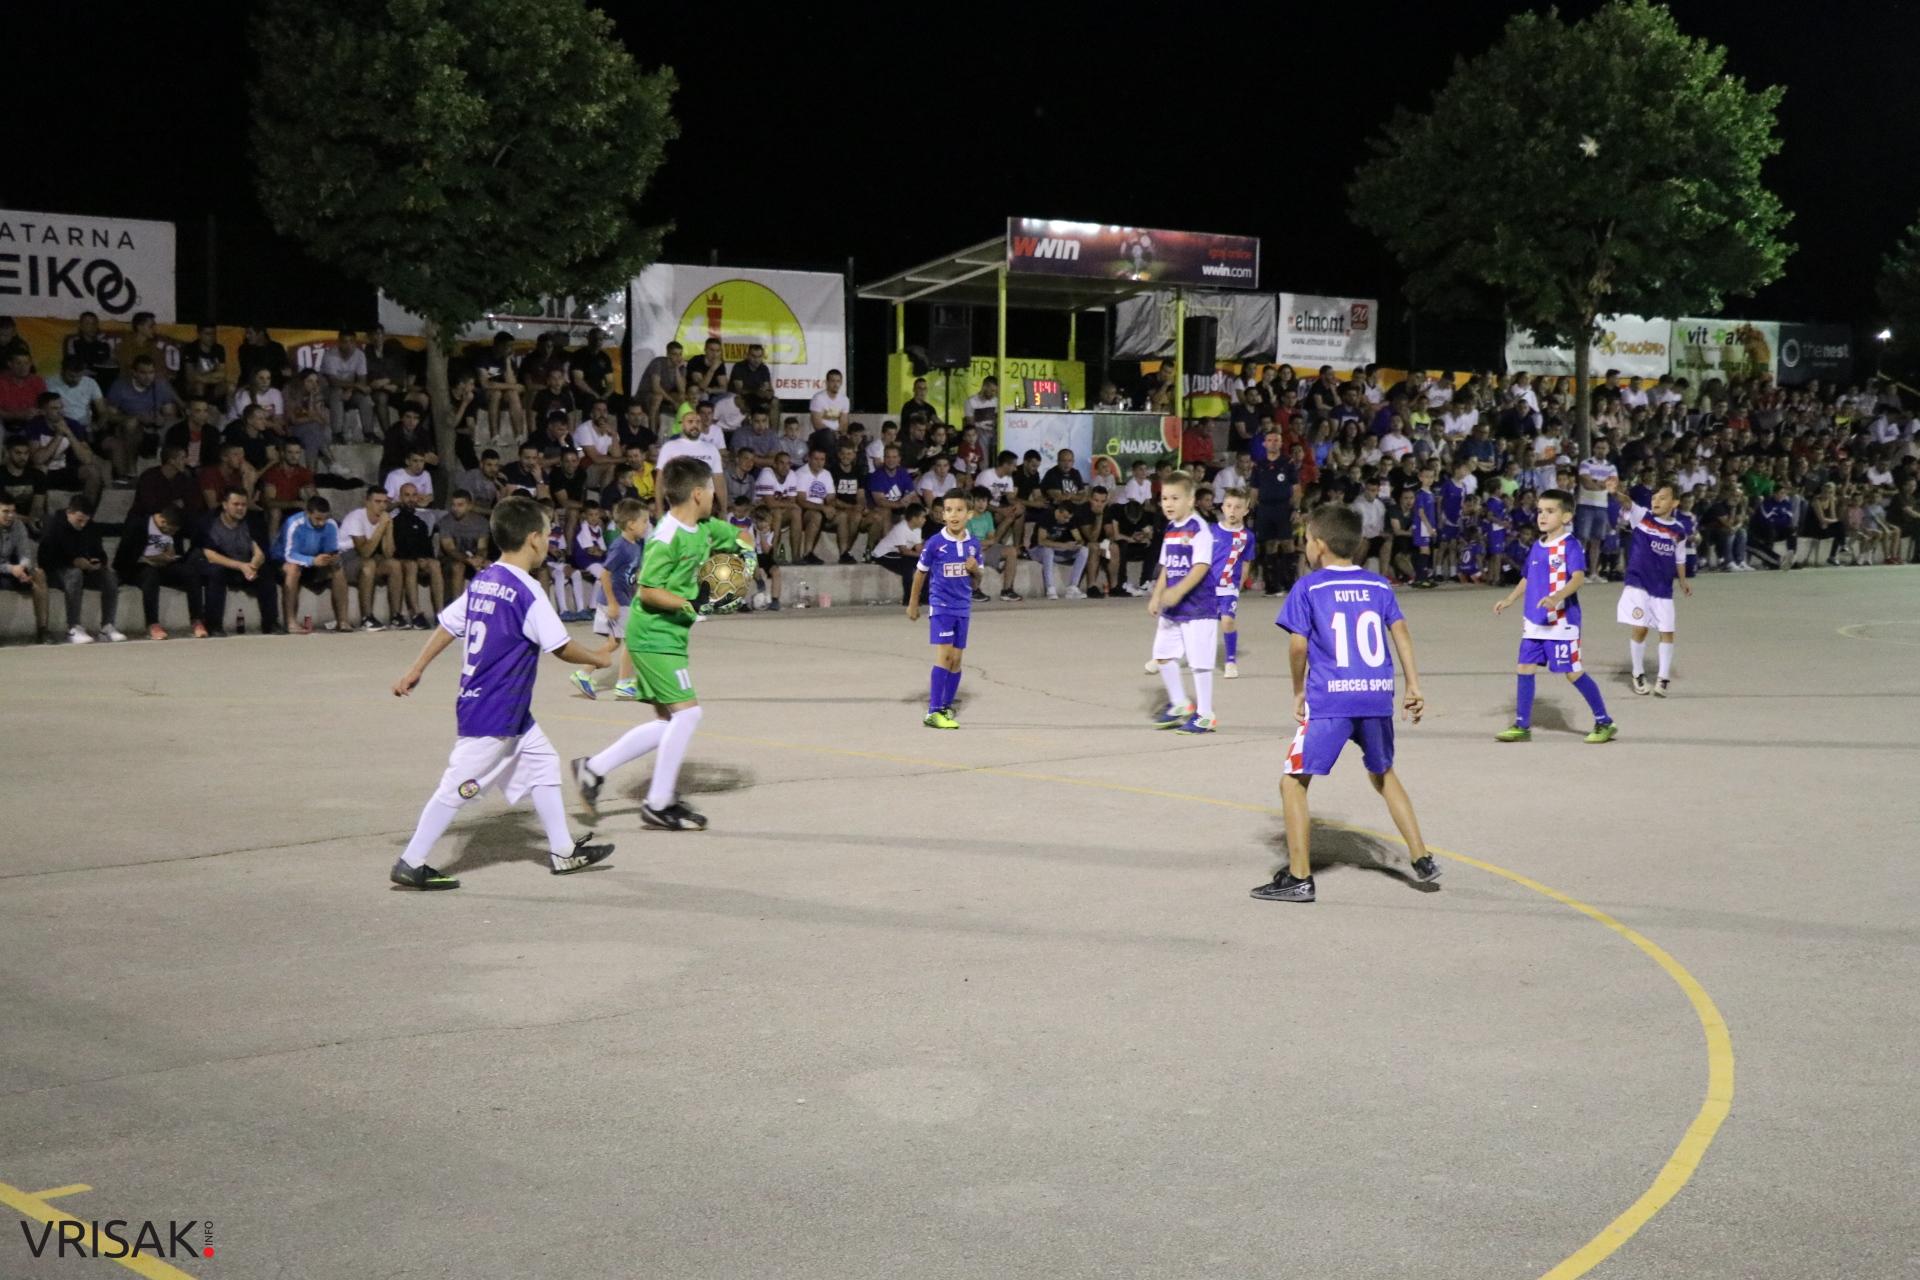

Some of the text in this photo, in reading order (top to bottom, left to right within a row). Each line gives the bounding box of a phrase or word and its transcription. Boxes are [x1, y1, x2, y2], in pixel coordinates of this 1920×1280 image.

[1202, 263, 1252, 278] wwin.com
[775, 378, 826, 390] DESETK
[1034, 393, 1041, 406] 3
[1119, 440, 1164, 454] NAMEX
[1334, 590, 1371, 602] KUTLE
[1231, 601, 1238, 611] 9
[1331, 611, 1386, 668] 10
[1555, 644, 1569, 659] 12
[1327, 679, 1368, 692] HERCEG
